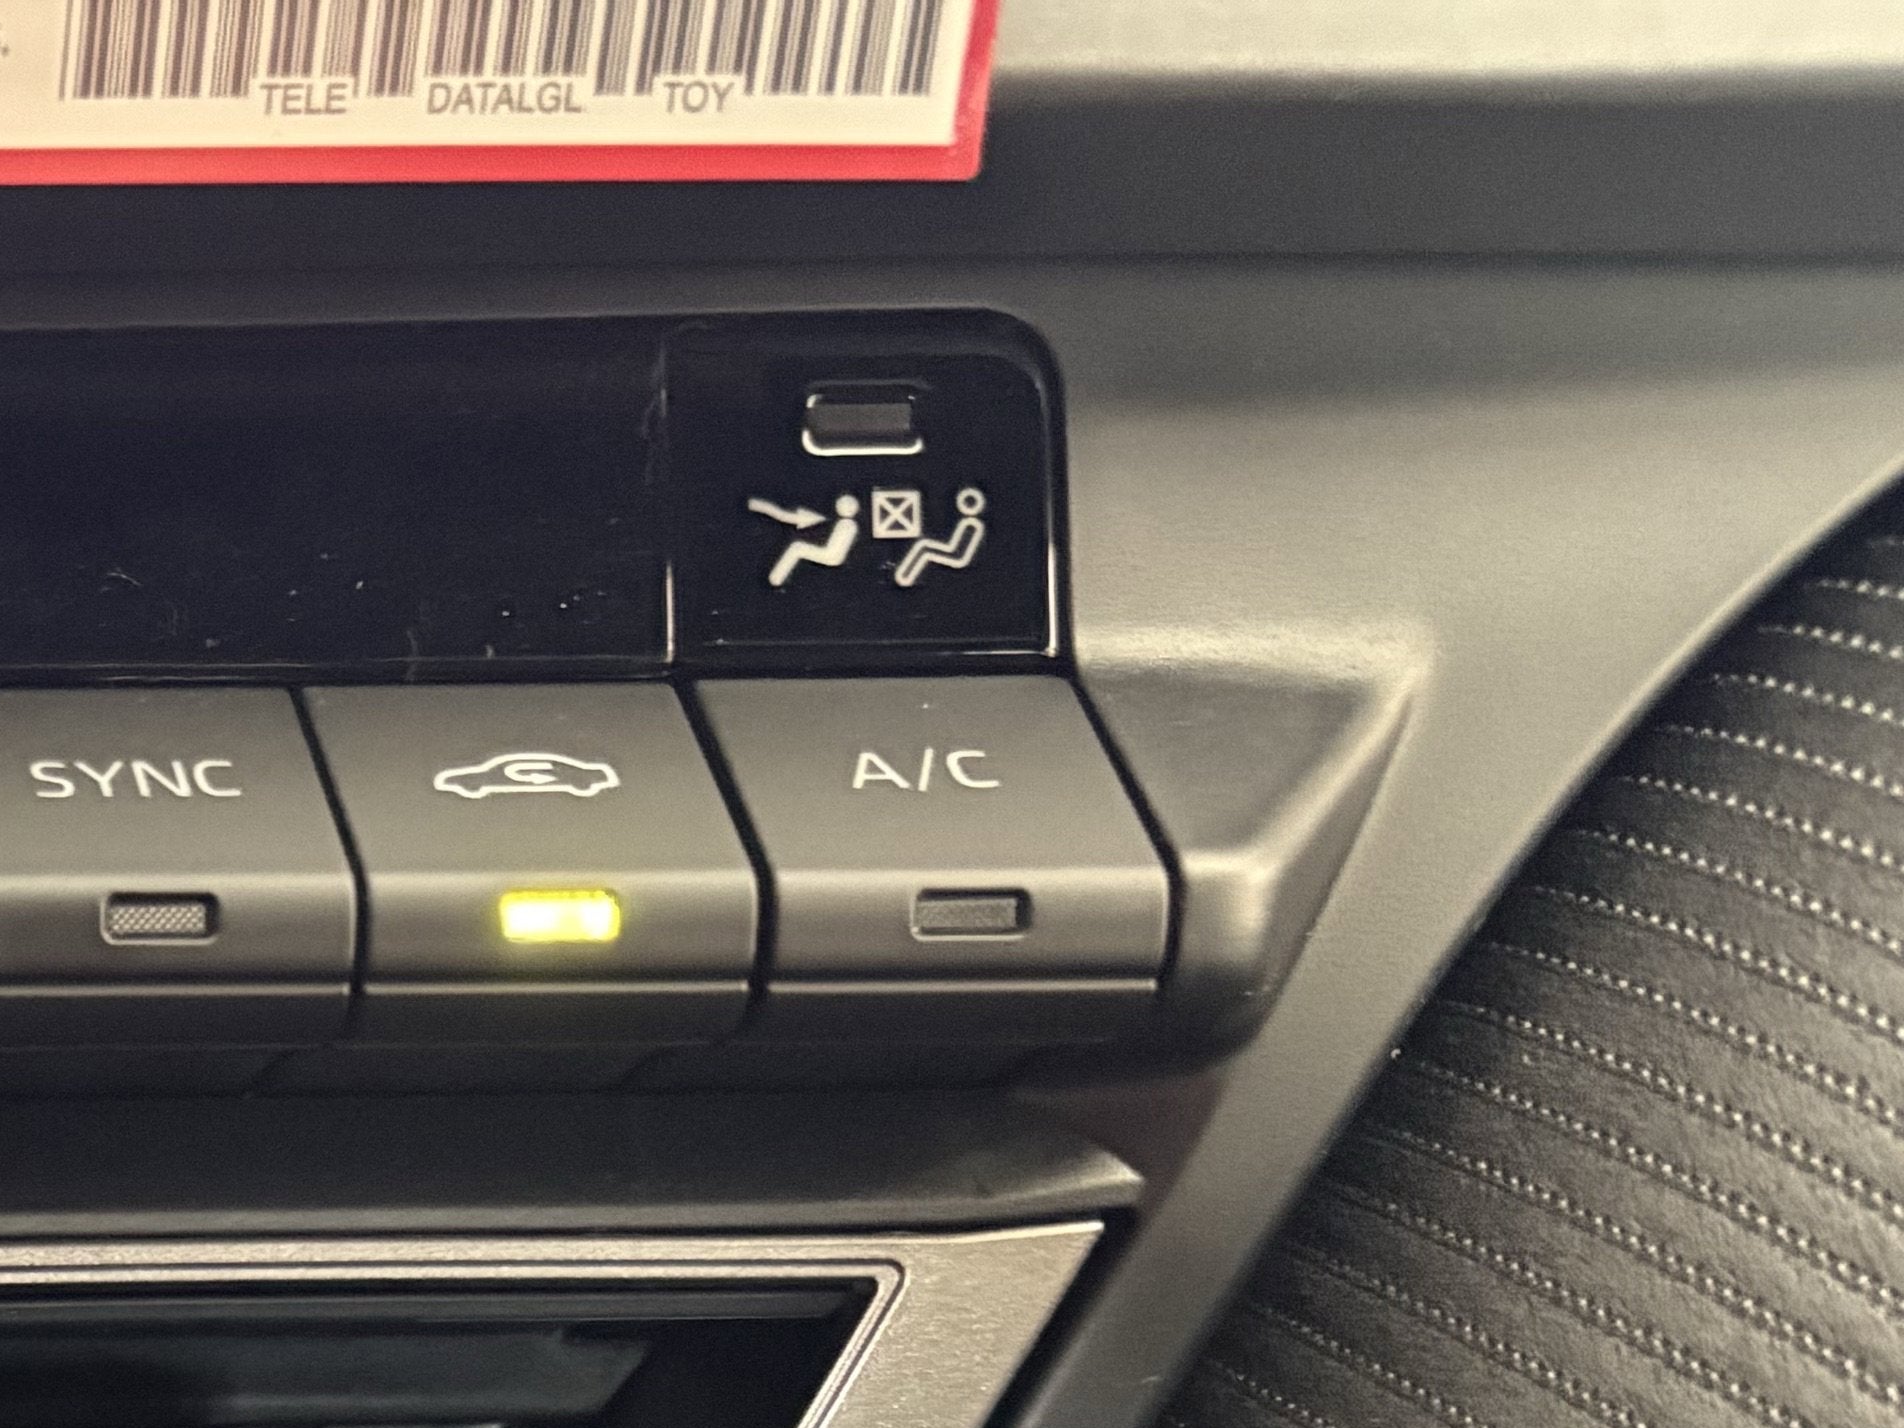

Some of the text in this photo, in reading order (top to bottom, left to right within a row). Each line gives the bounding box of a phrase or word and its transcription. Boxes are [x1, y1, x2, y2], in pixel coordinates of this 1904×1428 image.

[260, 80, 734, 115] TELE DATALGL TOY
[30, 760, 241, 798] SYNC
[853, 748, 1000, 791] A/C
